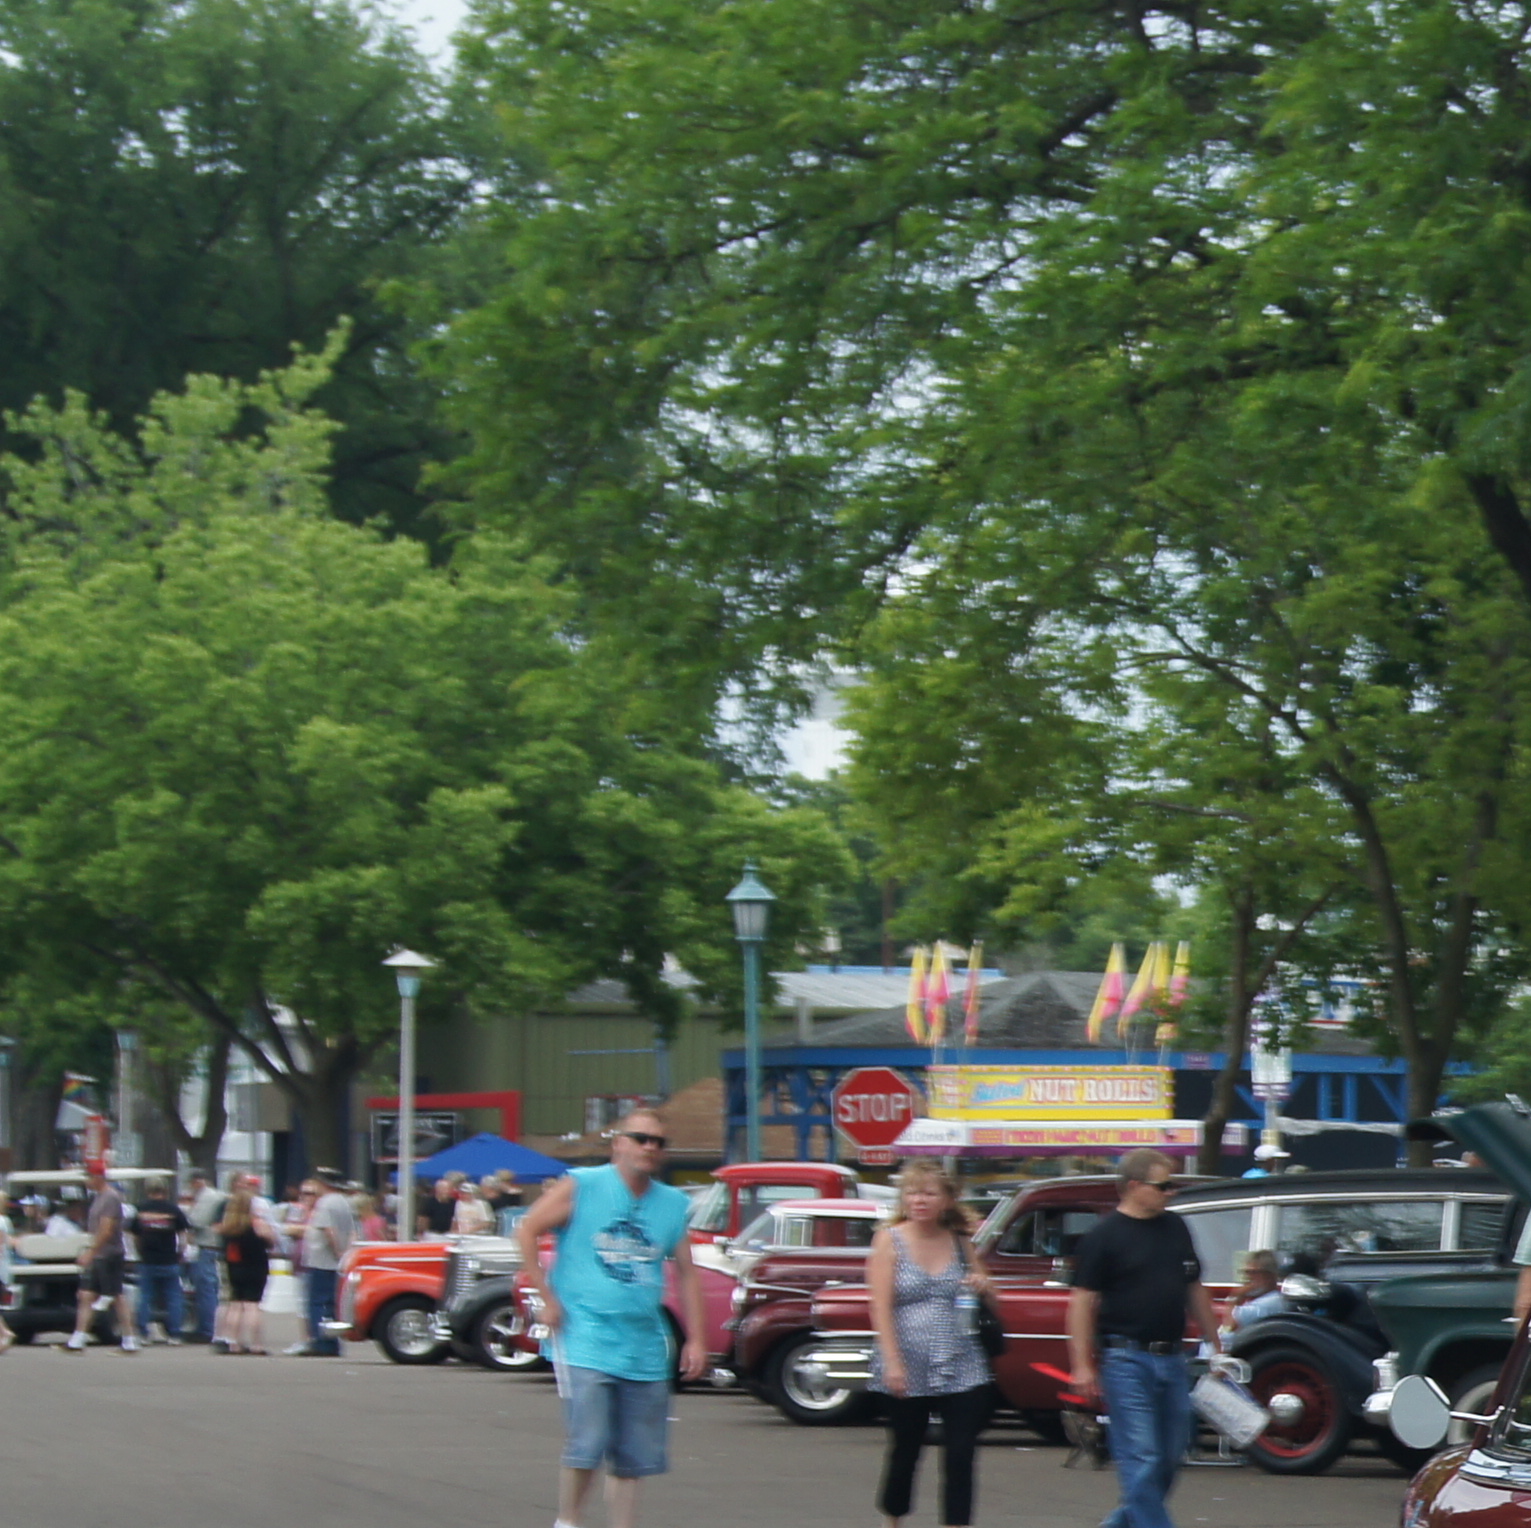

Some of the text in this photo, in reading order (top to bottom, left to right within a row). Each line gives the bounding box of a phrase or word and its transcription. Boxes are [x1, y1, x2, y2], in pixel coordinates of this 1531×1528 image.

[1028, 1078, 1077, 1102] NUT
[1083, 1078, 1156, 1102] ROLLS
[838, 1093, 908, 1122] STOP
